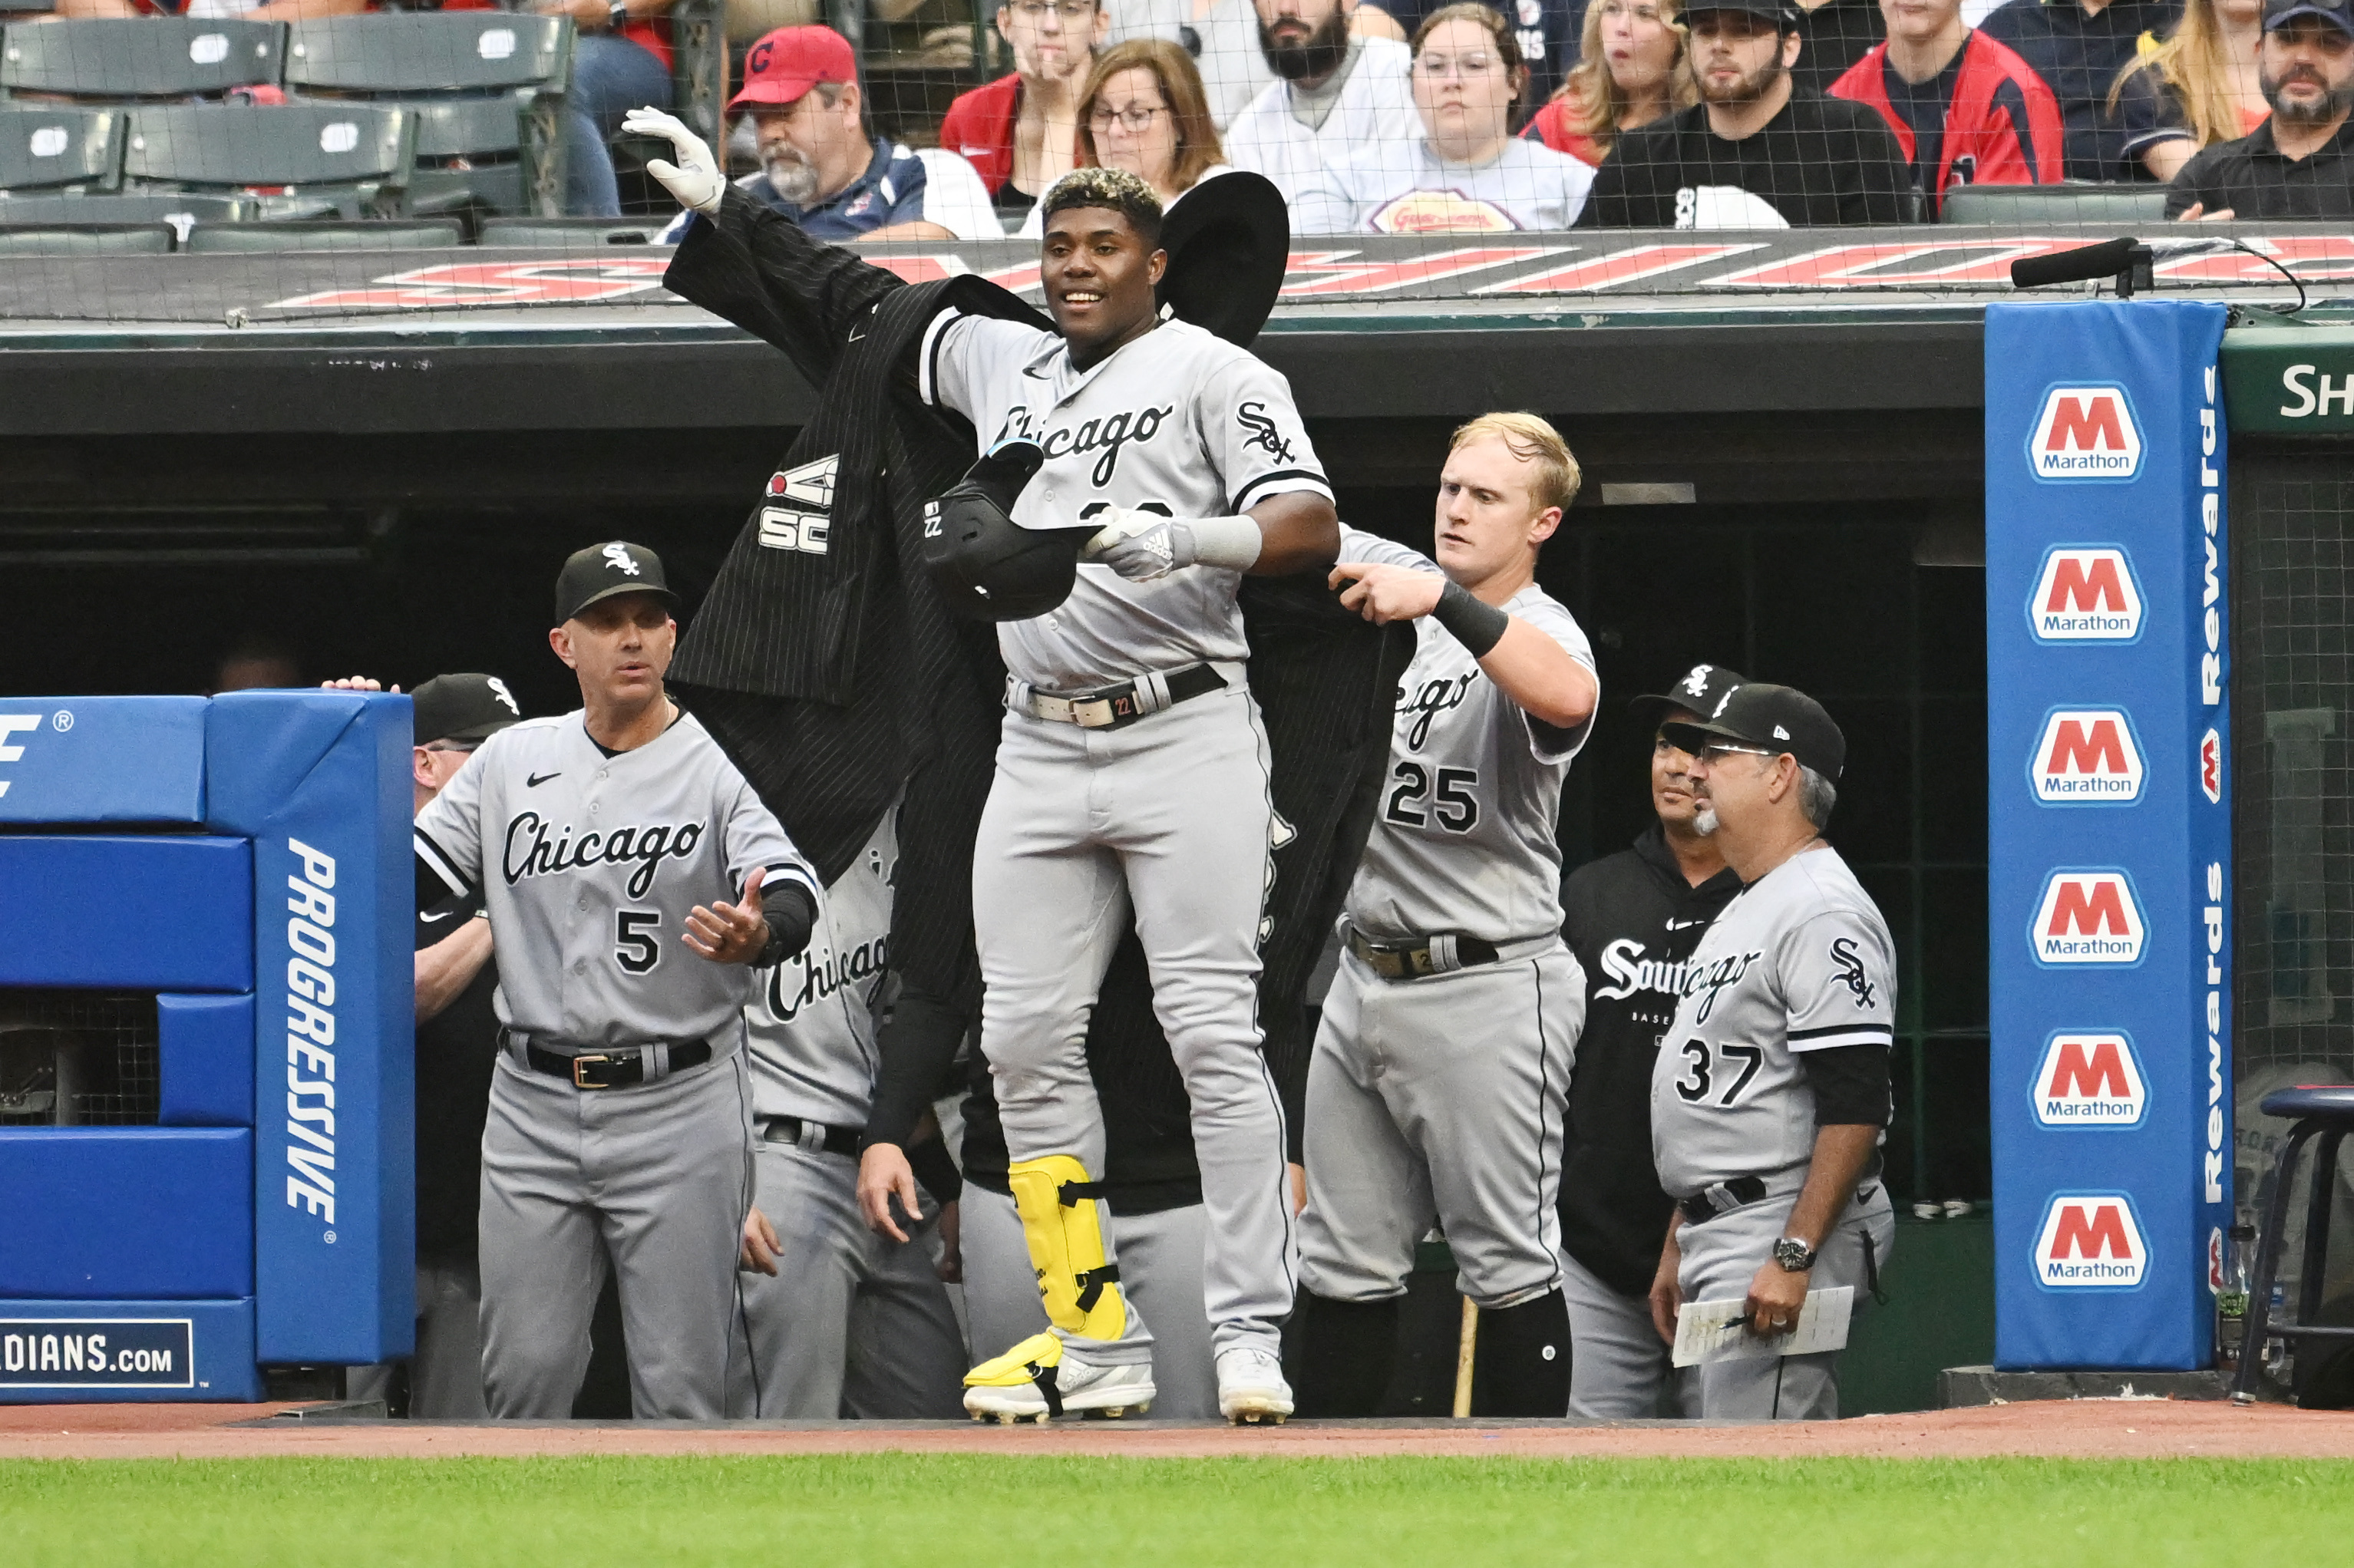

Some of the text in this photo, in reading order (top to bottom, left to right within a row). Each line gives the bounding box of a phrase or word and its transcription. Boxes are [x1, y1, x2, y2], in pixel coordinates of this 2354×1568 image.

[751, 41, 774, 73] C
[2048, 398, 2125, 450] M
[2044, 454, 2129, 470] Marathon
[2200, 365, 2221, 705] Rewards
[2048, 560, 2126, 611] M
[2044, 616, 2131, 631] Marathon
[1114, 697, 1131, 715] 22
[2048, 721, 2126, 772] M
[1384, 759, 1480, 835] 25
[2044, 777, 2131, 792] Marathon
[502, 810, 707, 901] Chicago
[2049, 883, 2128, 934] M
[614, 909, 662, 976] 5
[2045, 939, 2133, 954] Marathon
[287, 837, 335, 1224] PROGRESSIVE
[1632, 1012, 1669, 1025] BASE
[2204, 862, 2224, 1203] Rewards
[1674, 1036, 1765, 1108] 37
[2050, 1045, 2129, 1096] M
[2046, 1101, 2134, 1116] Marathon
[2051, 1207, 2131, 1258] M
[2047, 1263, 2135, 1278] Marathon
[0, 1333, 173, 1373] DIANS.COM
